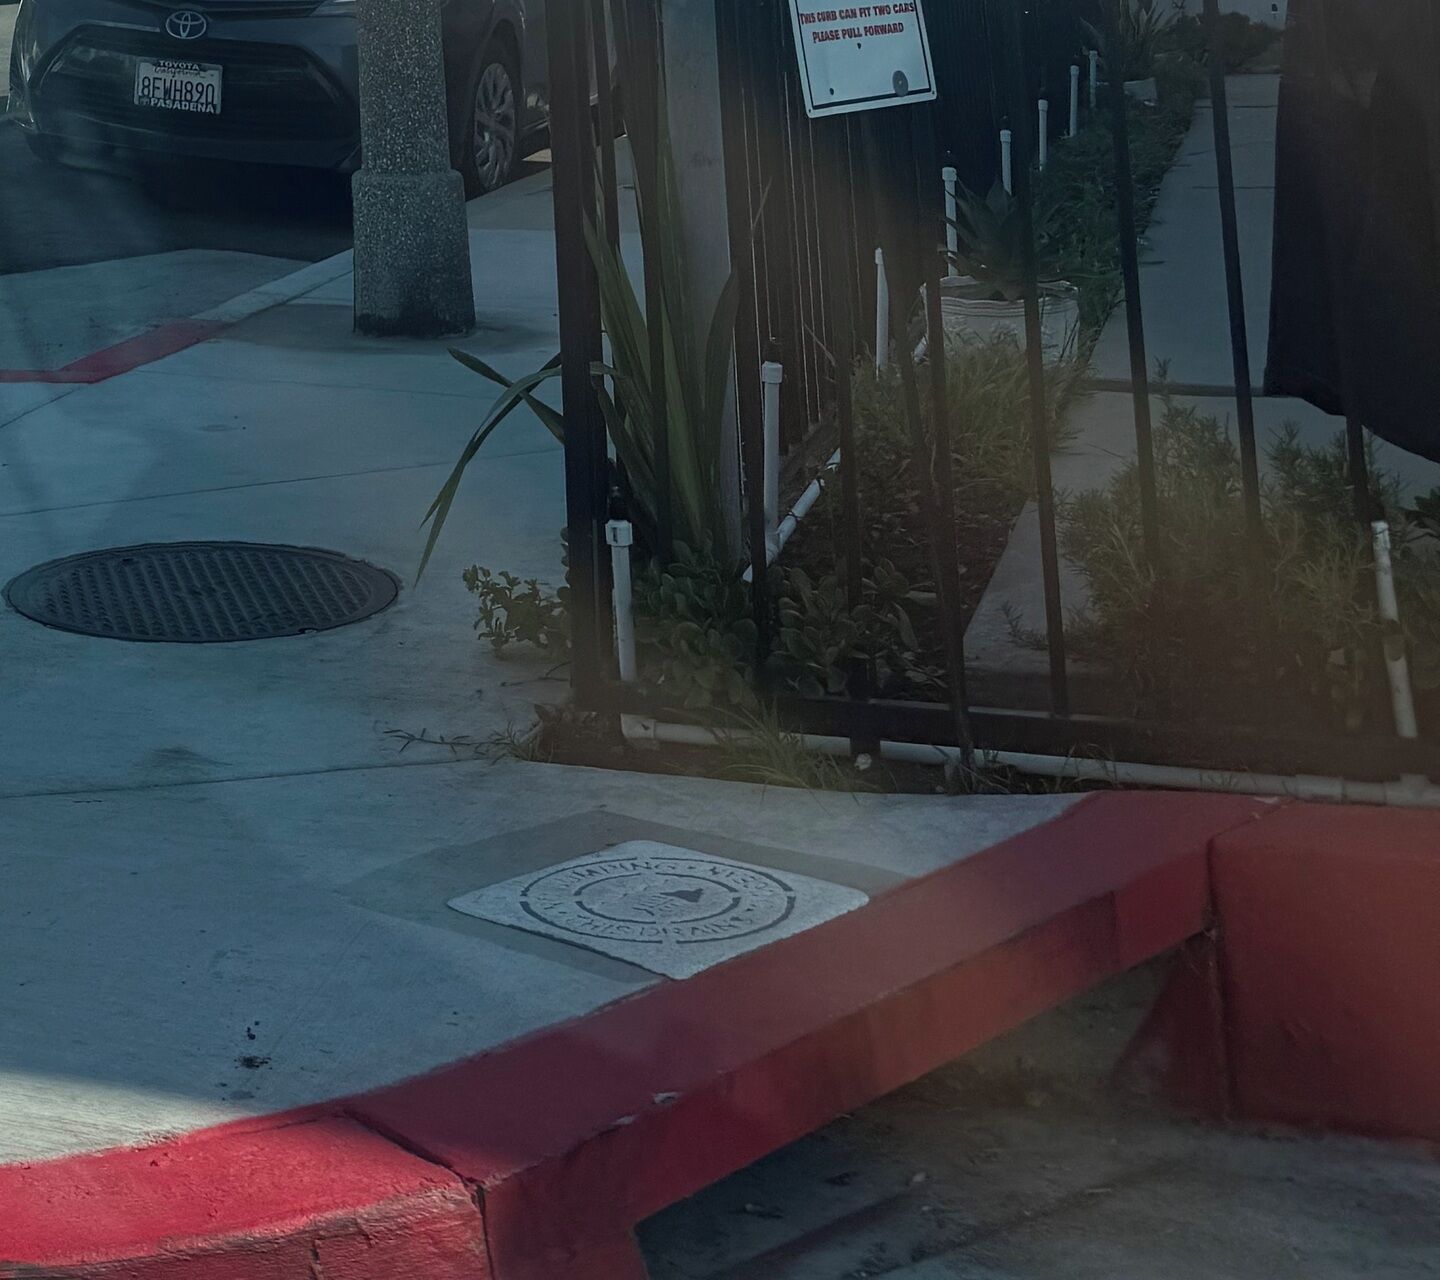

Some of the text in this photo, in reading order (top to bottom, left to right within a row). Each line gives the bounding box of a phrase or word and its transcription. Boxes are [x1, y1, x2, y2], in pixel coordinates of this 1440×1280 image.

[800, 2, 915, 24] THIS CURB CAN FIT TWO CARS
[812, 22, 904, 43] PLEASE PULL FORWARD
[160, 60, 199, 71] TOYOTA
[150, 97, 215, 113] PASADENA
